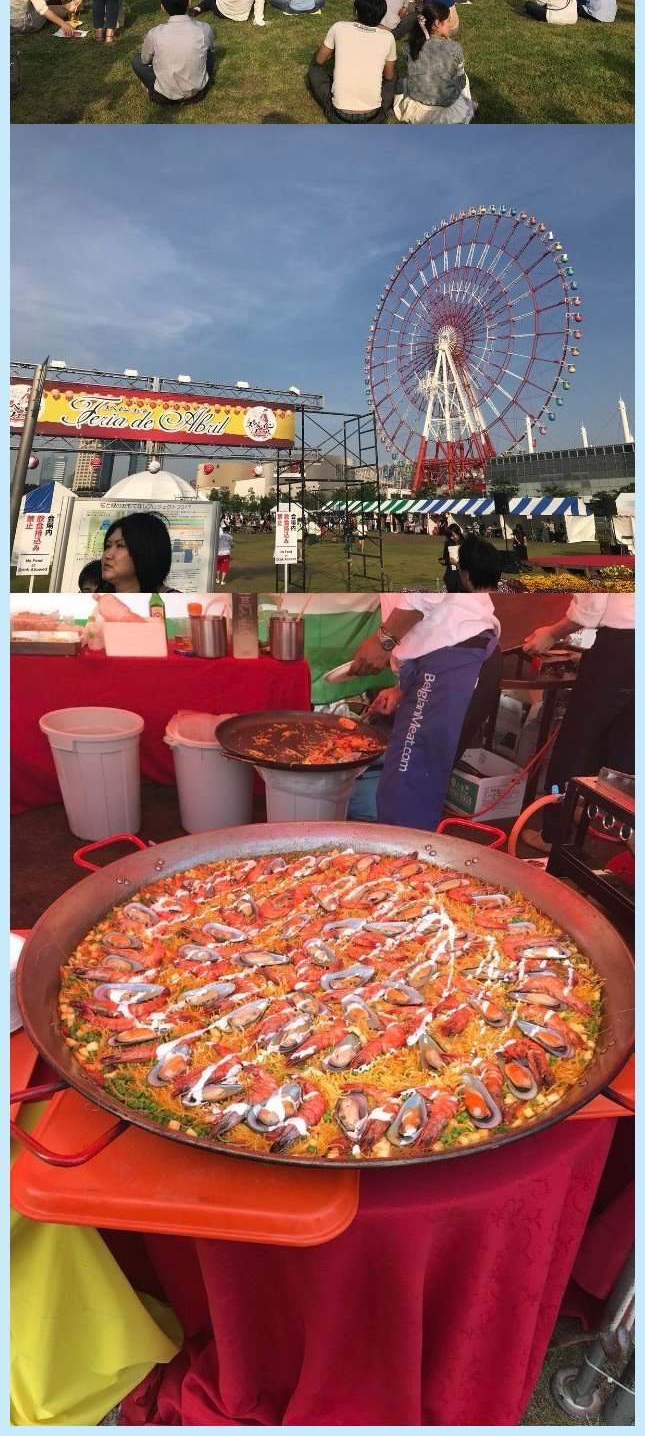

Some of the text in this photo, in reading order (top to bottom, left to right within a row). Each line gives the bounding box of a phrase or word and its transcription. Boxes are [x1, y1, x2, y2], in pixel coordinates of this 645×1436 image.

[61, 395, 128, 429] Feria
[131, 411, 155, 430] de
[159, 405, 231, 435] Abril
[398, 672, 436, 773] BelgianMeat.com
